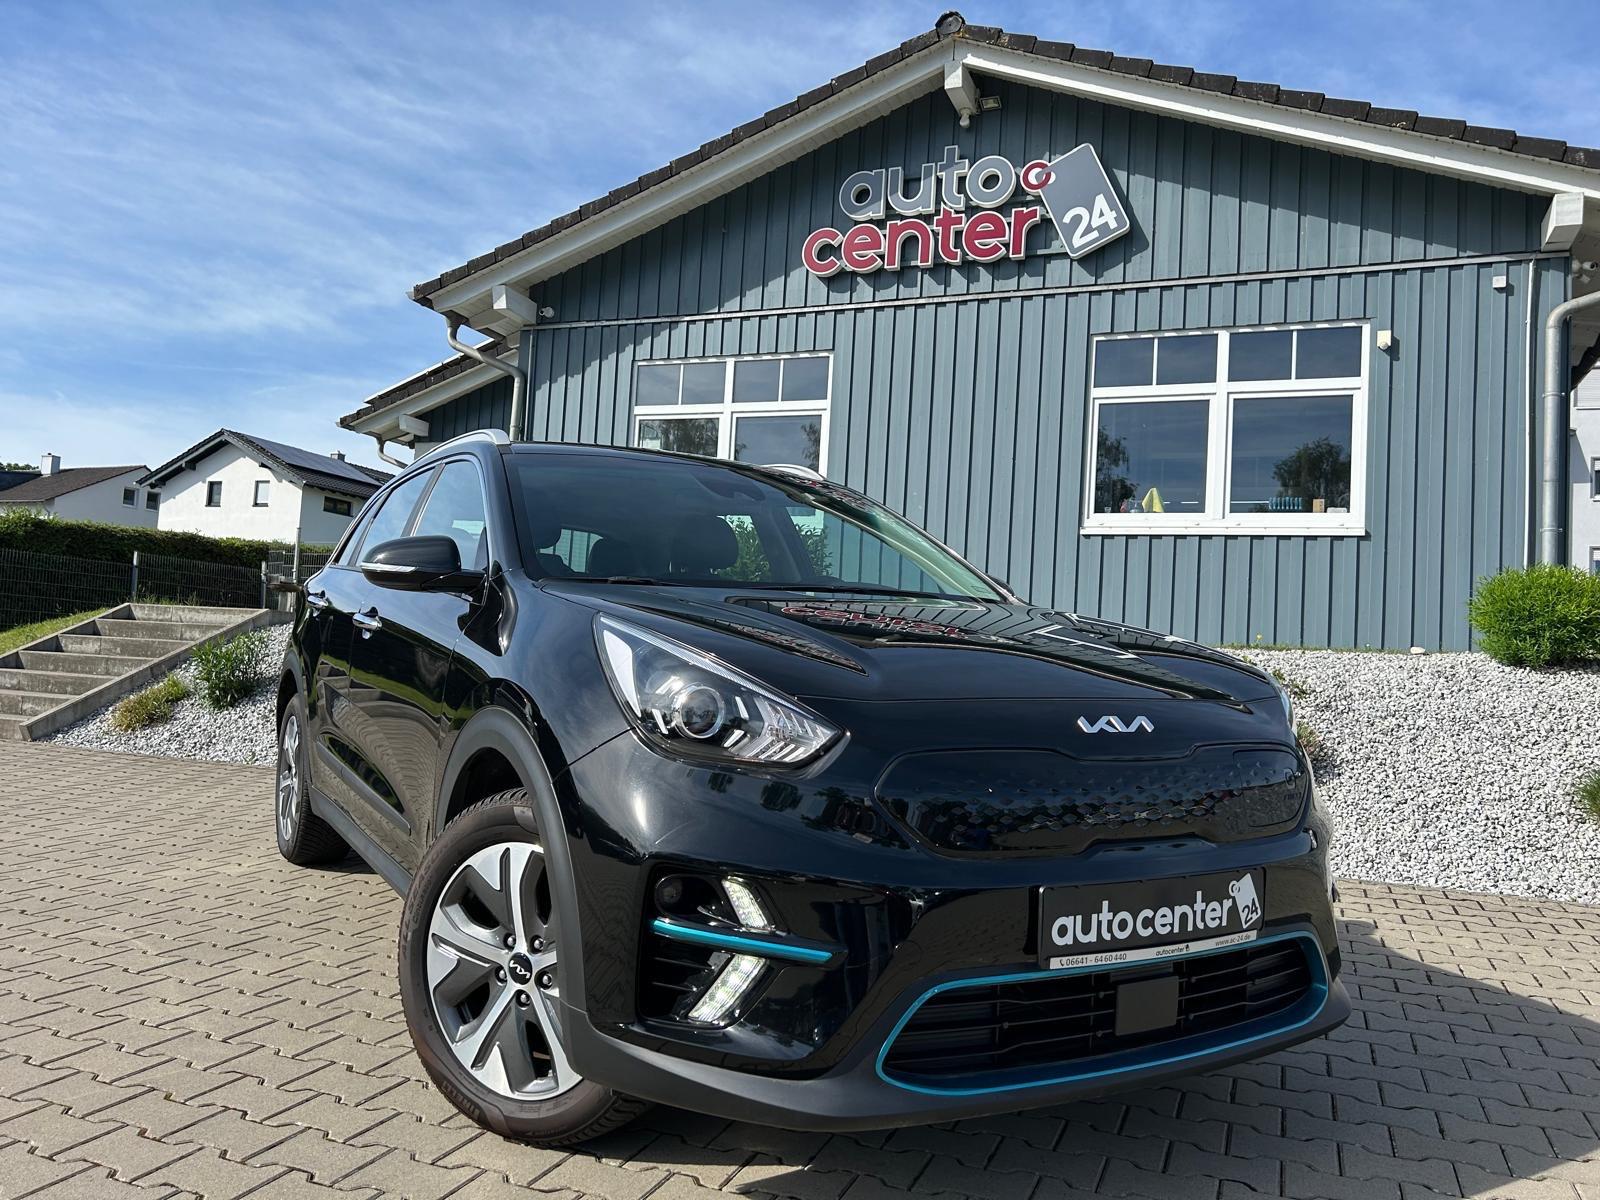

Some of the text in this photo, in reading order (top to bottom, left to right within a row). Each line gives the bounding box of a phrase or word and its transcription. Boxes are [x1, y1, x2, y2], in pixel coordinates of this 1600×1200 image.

[838, 145, 1017, 221] auto
[1062, 193, 1118, 249] 24
[802, 206, 1042, 277] center
[1077, 715, 1155, 733] KIA
[1051, 890, 1259, 946] autocenter 24
[1155, 945, 1185, 957] autocenter
[1215, 933, 1251, 947] www.ac-24.de
[1065, 956, 1088, 967] 06641
